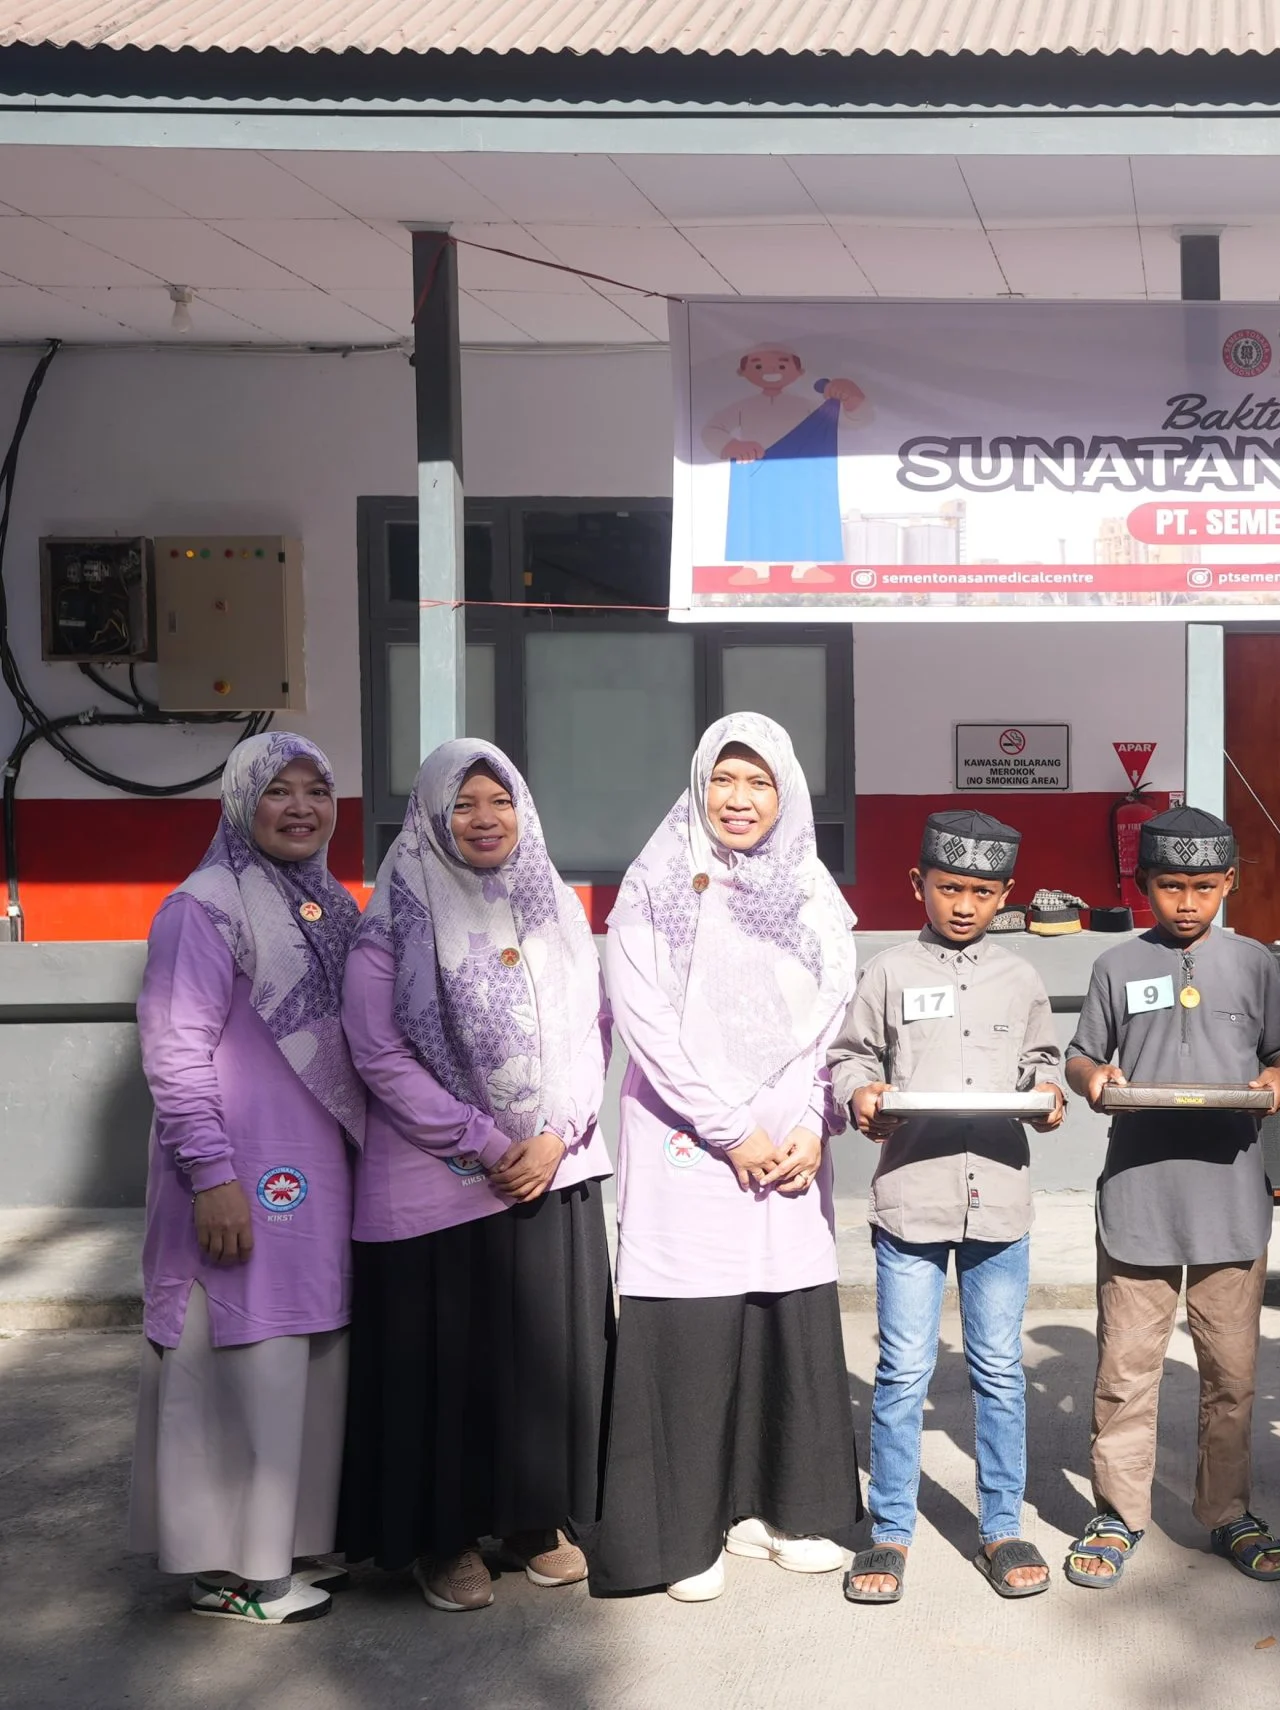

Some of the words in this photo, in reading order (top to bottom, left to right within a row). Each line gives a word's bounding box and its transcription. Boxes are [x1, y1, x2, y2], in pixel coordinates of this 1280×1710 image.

[1156, 508, 1197, 535] PT.
[882, 571, 1094, 584] sementonasamedicalcentre
[1118, 743, 1153, 752] APAR
[964, 759, 1011, 767] KAWASAN
[1013, 759, 1061, 767] DILARANG
[990, 768, 1035, 776] MEROKOK
[966, 776, 983, 785] (NO
[986, 776, 1030, 785] SMOKING
[1031, 776, 1059, 785] AREA)
[1144, 985, 1159, 1005] 9
[914, 992, 946, 1012] 17
[267, 1214, 294, 1223] KIKST
